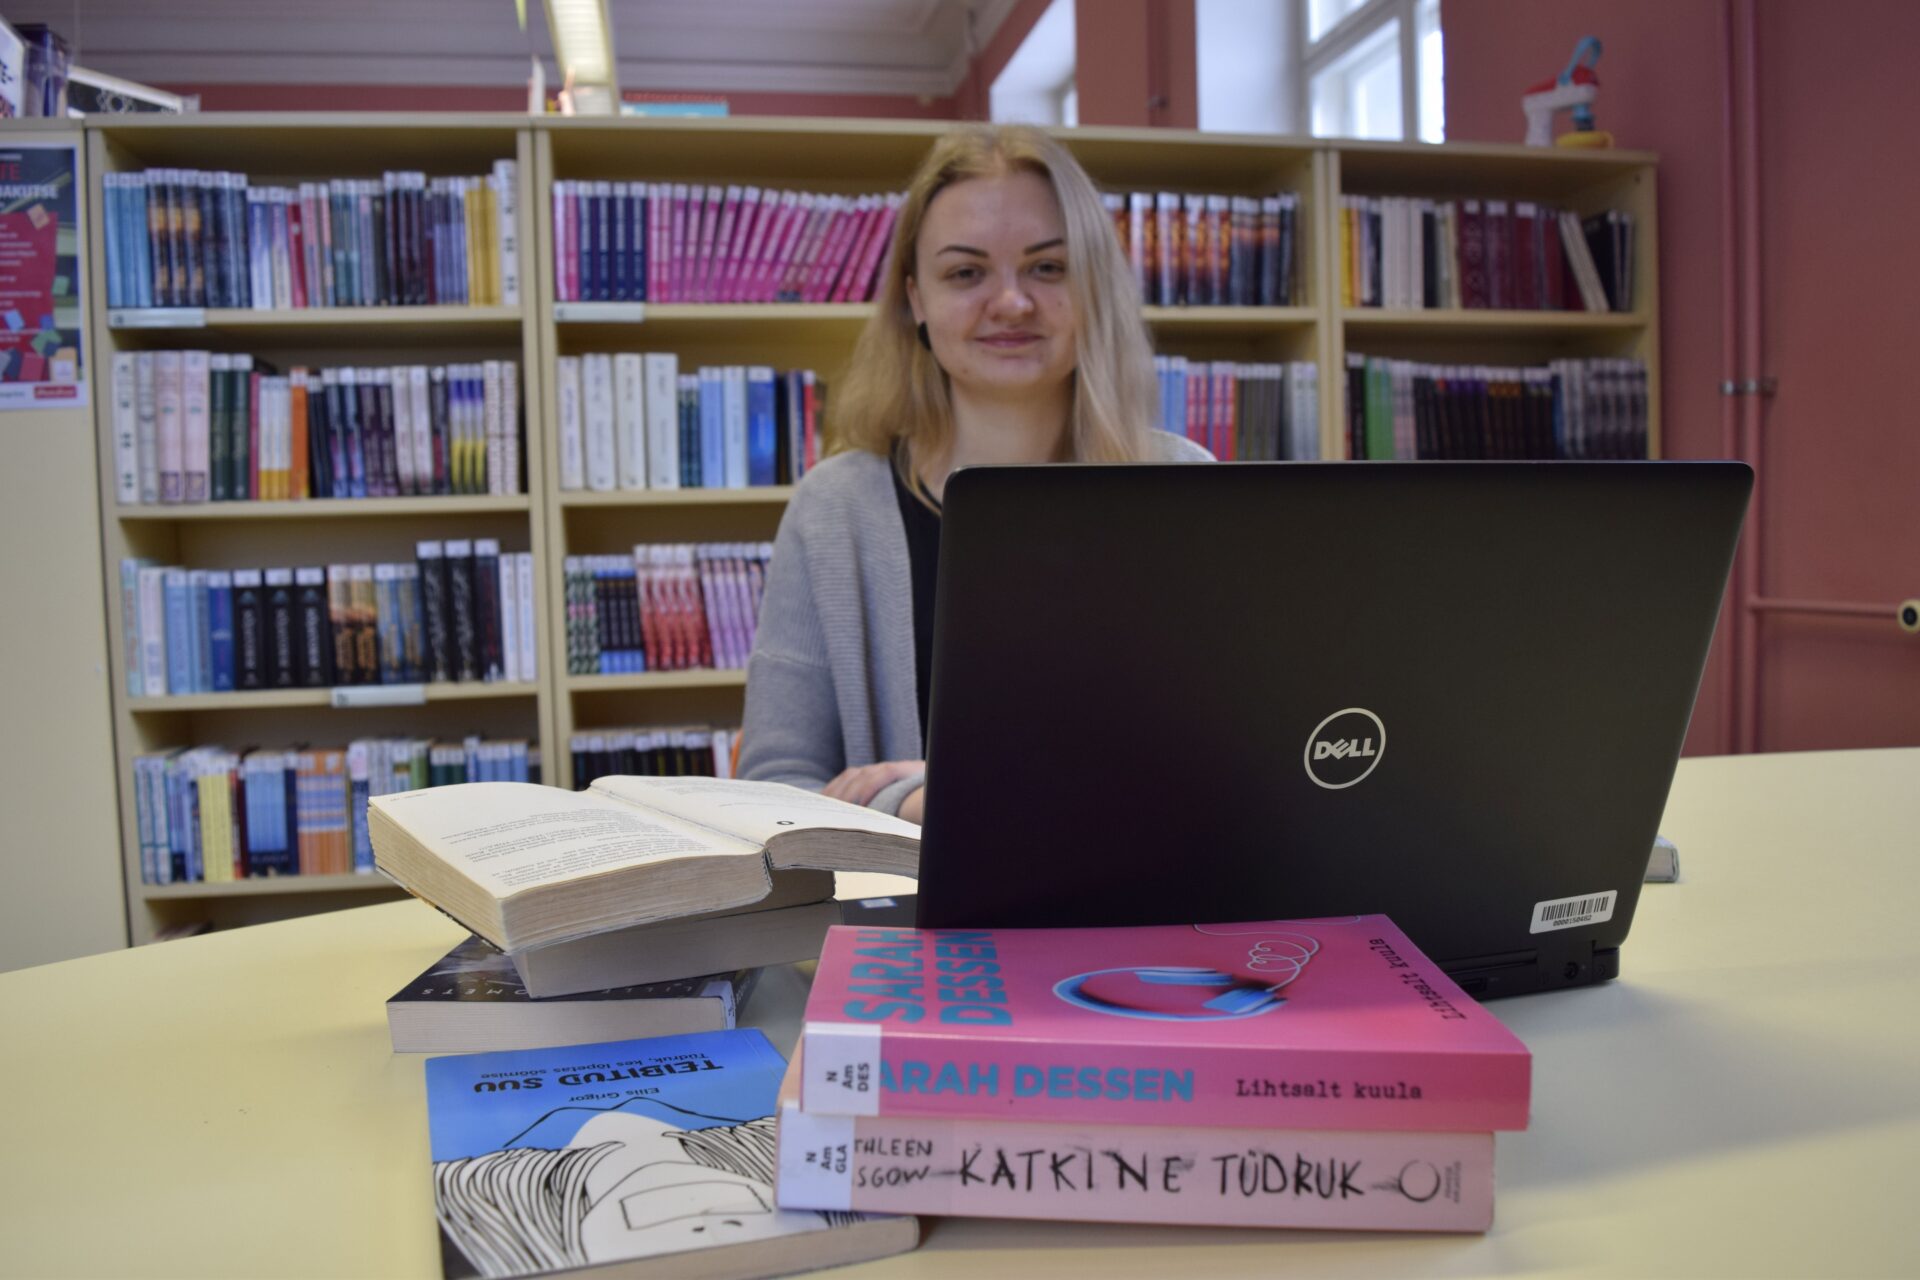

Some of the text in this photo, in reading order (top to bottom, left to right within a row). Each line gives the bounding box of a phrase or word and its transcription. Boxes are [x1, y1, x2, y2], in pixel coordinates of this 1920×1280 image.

[1313, 737, 1376, 760] DELL
[842, 929, 1013, 1026] SARAH DESSEN
[1368, 938, 1467, 1020] Lihtsalt kuula
[421, 987, 528, 997] OMETS
[472, 1058, 725, 1094] TEIBITUD SUU
[615, 1059, 643, 1069] kes
[826, 1070, 838, 1082] N
[842, 1064, 854, 1090] Am
[857, 1062, 870, 1092] DES
[880, 1060, 1422, 1101] ARAH DESSEN Lihtsalt kuula
[568, 1091, 620, 1103] Grigor
[805, 1151, 817, 1163] N
[820, 1146, 832, 1171] Am
[835, 1144, 848, 1174] GLA
[853, 1137, 934, 1158] THLEEN
[856, 1147, 1366, 1200] SGOW KATKINE TÜDRUK
